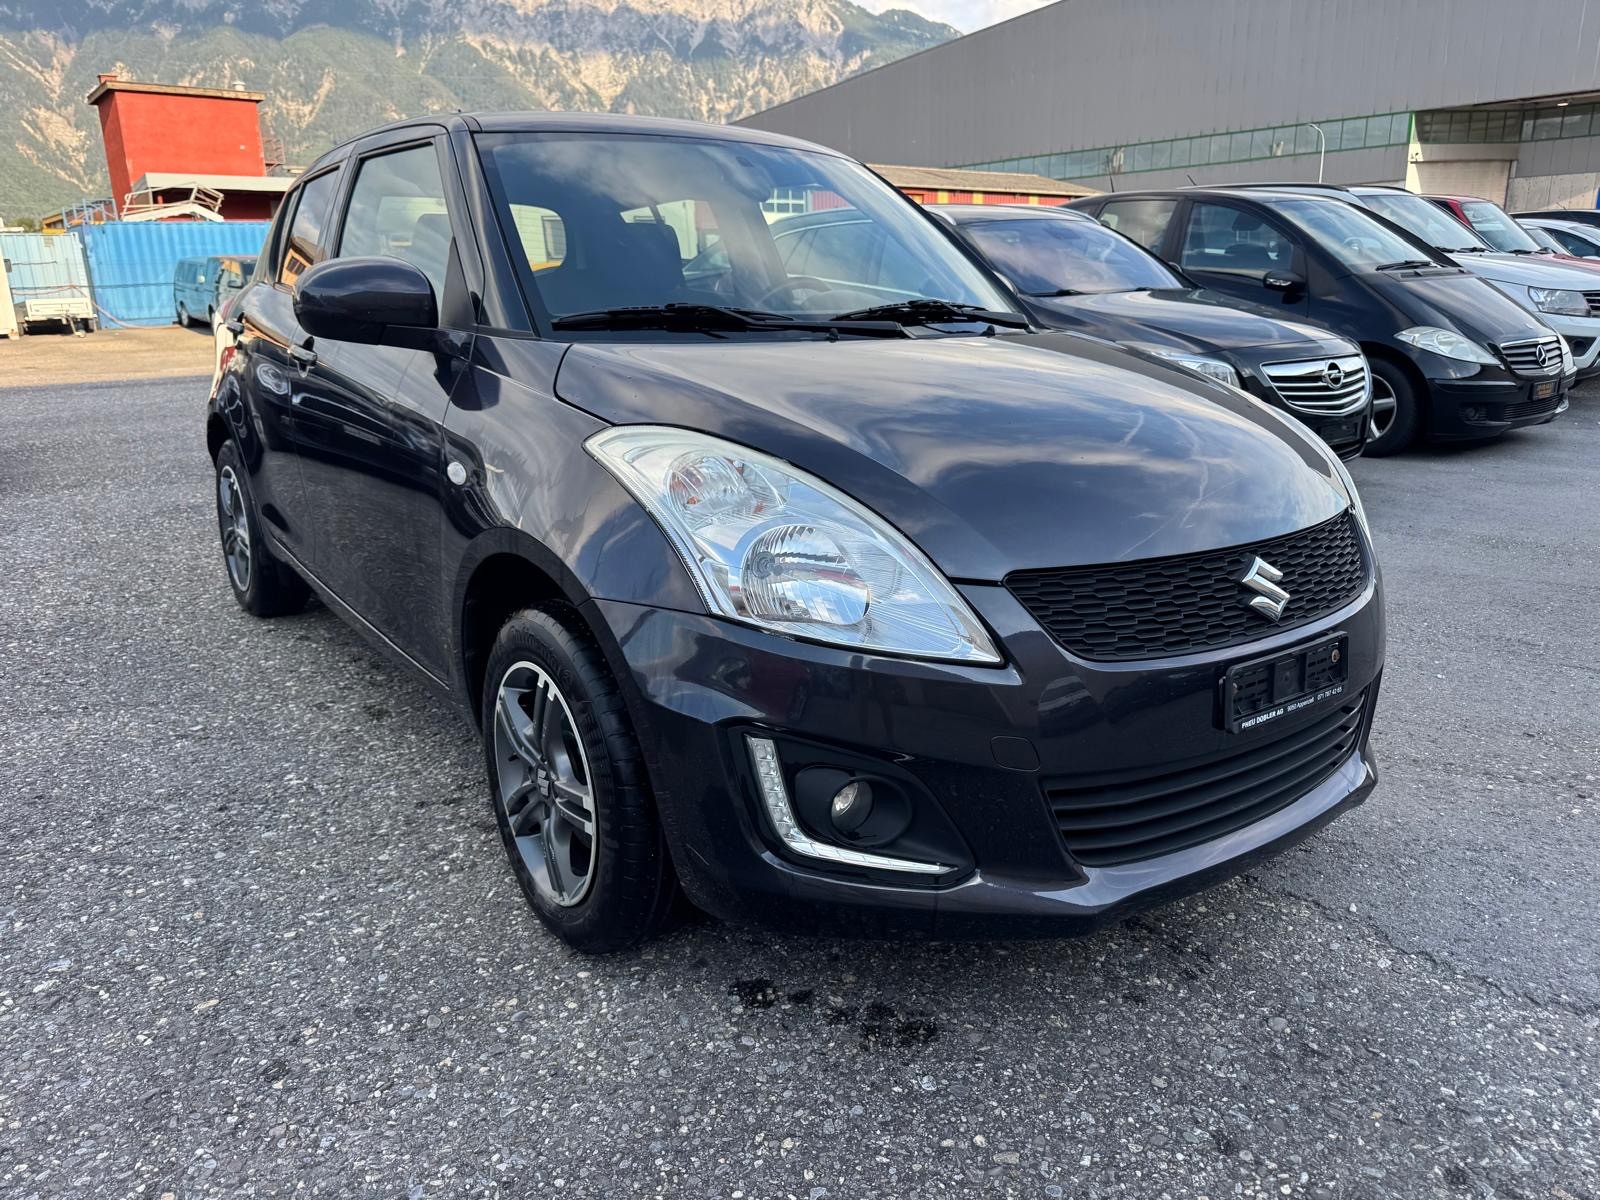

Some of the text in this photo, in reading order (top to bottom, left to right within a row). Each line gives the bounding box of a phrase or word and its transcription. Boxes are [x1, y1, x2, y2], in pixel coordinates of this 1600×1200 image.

[1241, 719, 1256, 729] PNEU
[1256, 711, 1276, 723] DOBLER
[1276, 708, 1284, 716] AG
